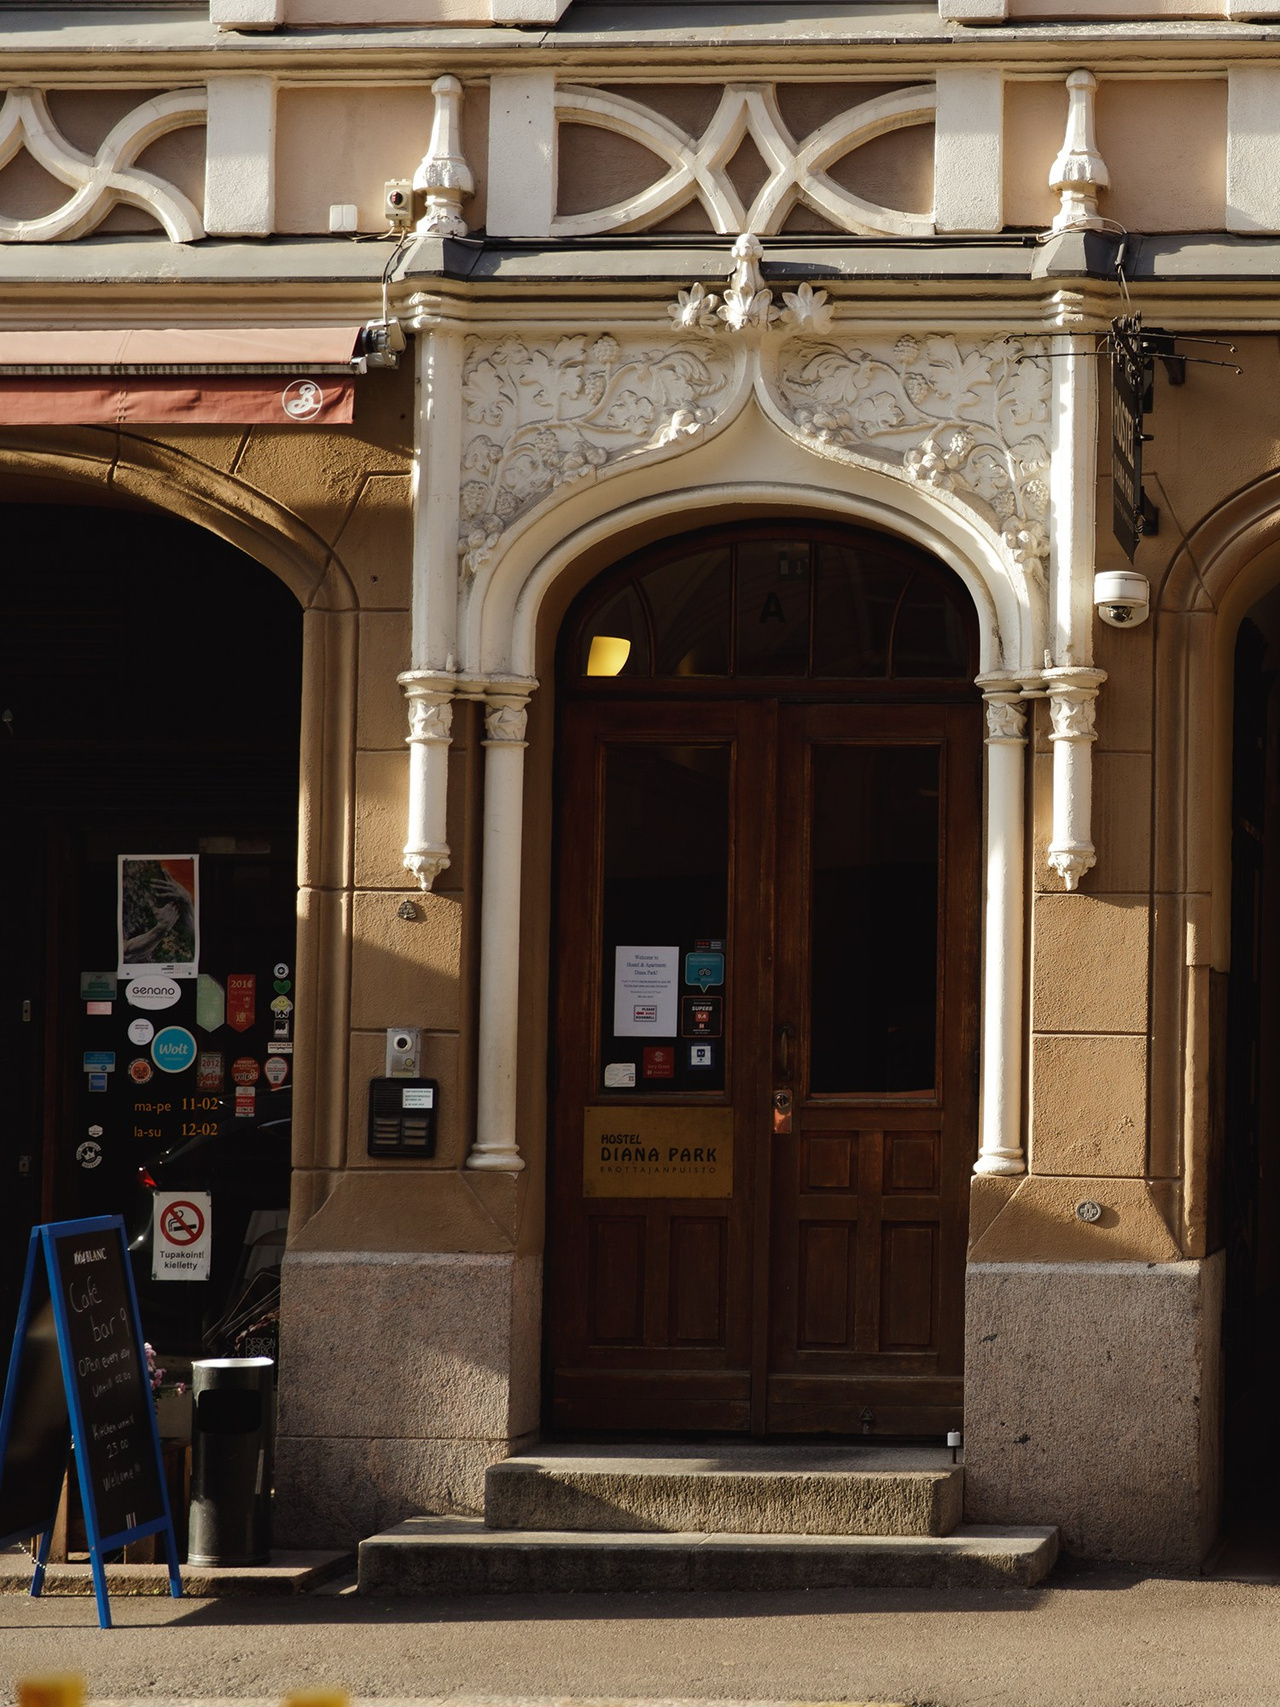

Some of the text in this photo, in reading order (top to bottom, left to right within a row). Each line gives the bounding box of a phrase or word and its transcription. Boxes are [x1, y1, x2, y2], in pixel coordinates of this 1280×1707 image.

[759, 592, 787, 623] A
[159, 1042, 189, 1055] Wolt
[134, 1097, 219, 1115] ma-pe 11-02
[134, 1123, 219, 1138] la-su 12-02
[601, 1134, 642, 1145] HOSTEL
[601, 1147, 717, 1162] DIANA PARK
[600, 1166, 716, 1175] EROTTAJANPUISTO
[159, 1251, 205, 1260] Tupakointi
[164, 1262, 198, 1271] kielletty
[69, 1275, 103, 1313] Café
[89, 1314, 116, 1343] bar
